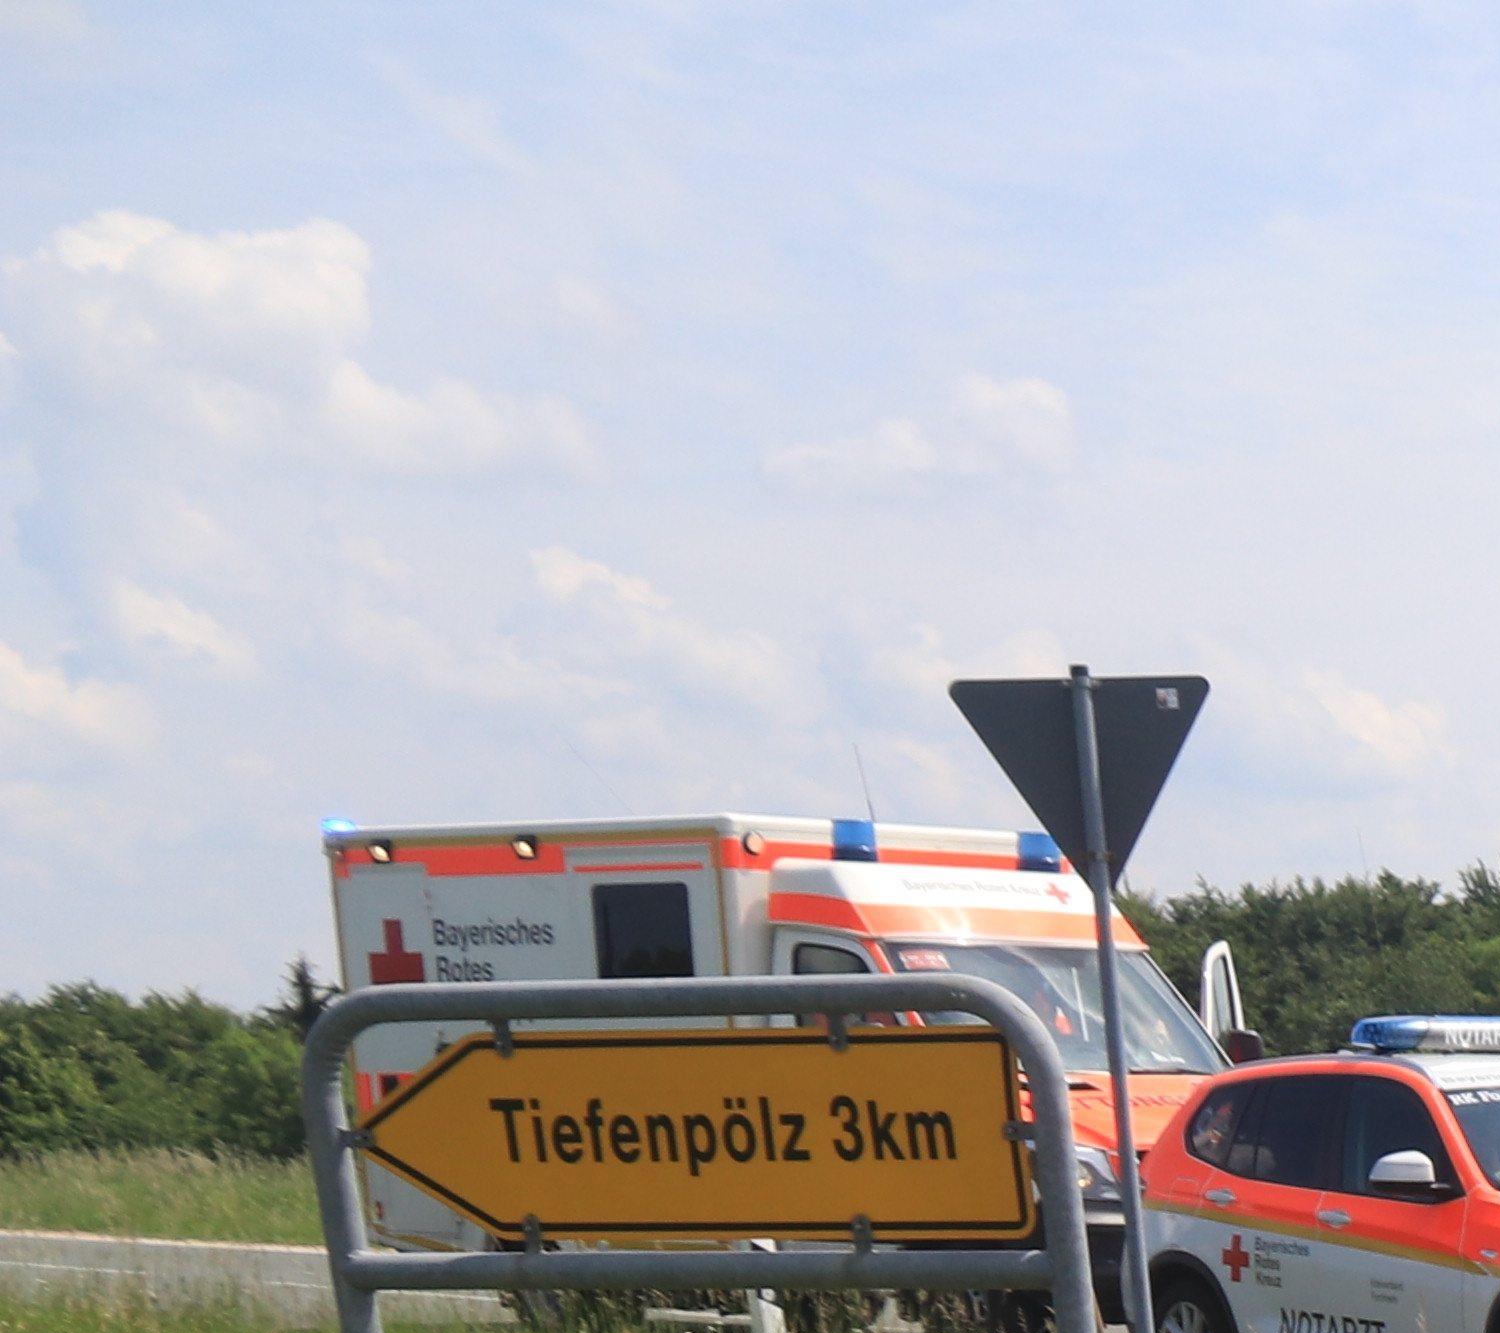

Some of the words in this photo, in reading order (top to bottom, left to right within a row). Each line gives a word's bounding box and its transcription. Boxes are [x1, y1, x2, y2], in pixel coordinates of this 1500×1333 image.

[432, 917, 554, 951] Bayerisches
[436, 955, 495, 982] Rotes
[489, 1096, 812, 1177] Tiefenpölz
[829, 1095, 958, 1162] 3km
